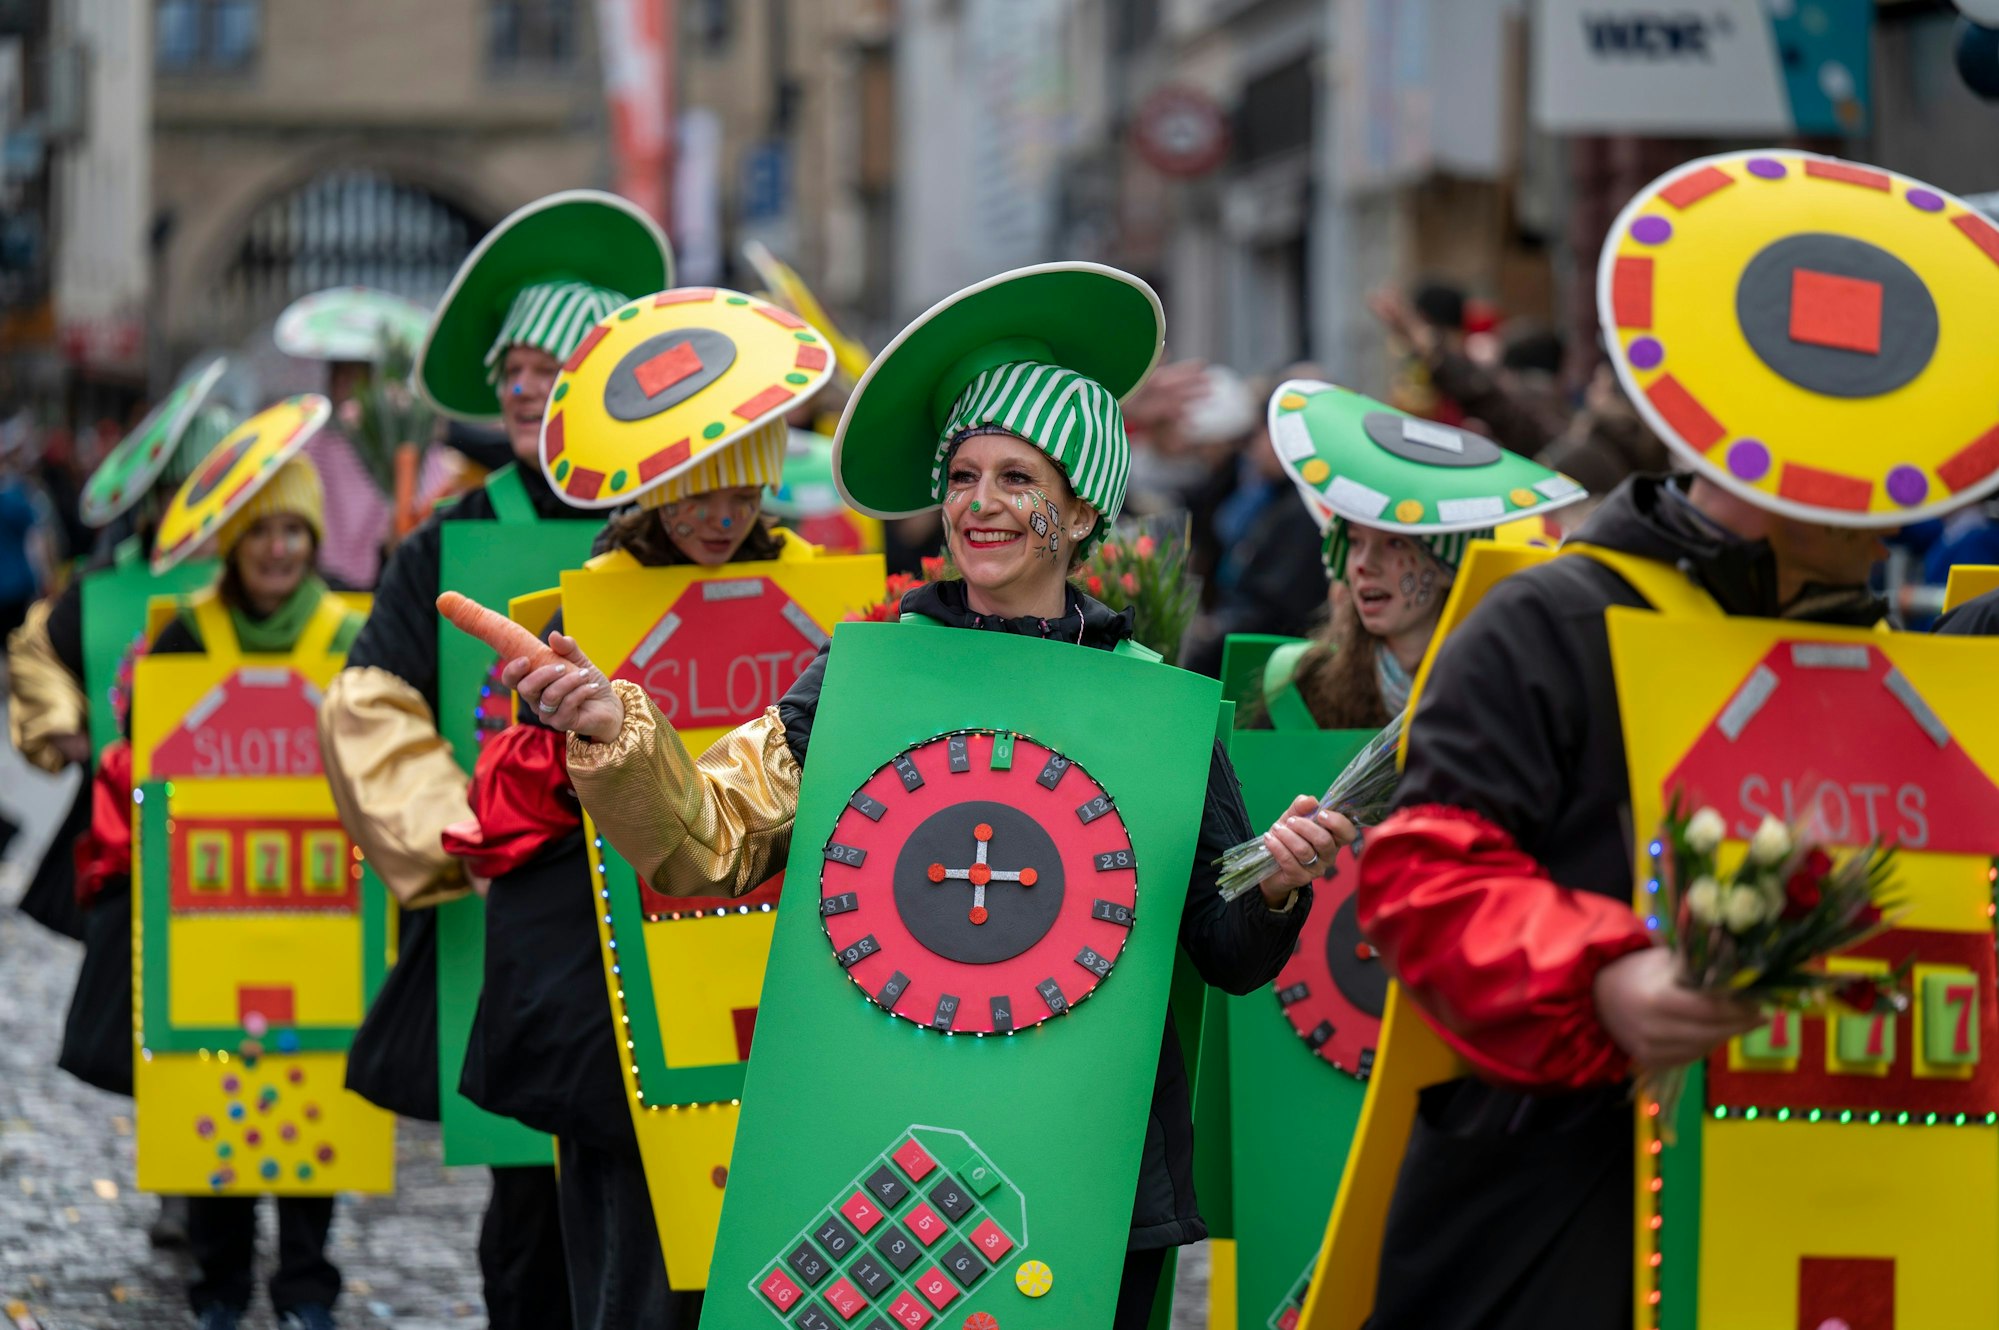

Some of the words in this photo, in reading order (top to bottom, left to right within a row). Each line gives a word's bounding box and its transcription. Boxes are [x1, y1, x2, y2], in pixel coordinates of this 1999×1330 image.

[192, 726, 317, 780] SLOTS
[950, 741, 966, 764] 17
[998, 745, 1009, 758] 0
[897, 758, 918, 782] 31
[1043, 756, 1065, 780] 38
[861, 799, 873, 813] 7
[1082, 798, 1108, 819] 12
[833, 846, 858, 862] 26
[1101, 851, 1128, 869] 28
[825, 895, 849, 913] 18
[1101, 904, 1127, 921] 16
[846, 940, 872, 962] 36
[1083, 951, 1110, 974] 32
[1043, 984, 1066, 1009] 15
[936, 1000, 954, 1024] 21
[995, 1008, 1010, 1020] 4
[1945, 984, 1975, 1055] 7
[972, 1166, 986, 1181] 0
[881, 1182, 895, 1196] 4
[942, 1192, 958, 1208] 2
[855, 1205, 869, 1219] 7
[918, 1215, 933, 1230] 5
[821, 1227, 846, 1250] 10
[891, 1240, 906, 1254] 8
[985, 1233, 999, 1248] 3
[795, 1252, 820, 1276] 13
[955, 1257, 970, 1271] 6
[857, 1263, 880, 1286] 11
[767, 1278, 793, 1302] 16
[928, 1280, 943, 1294] 9
[830, 1288, 855, 1313] 14
[896, 1302, 921, 1326] 12
